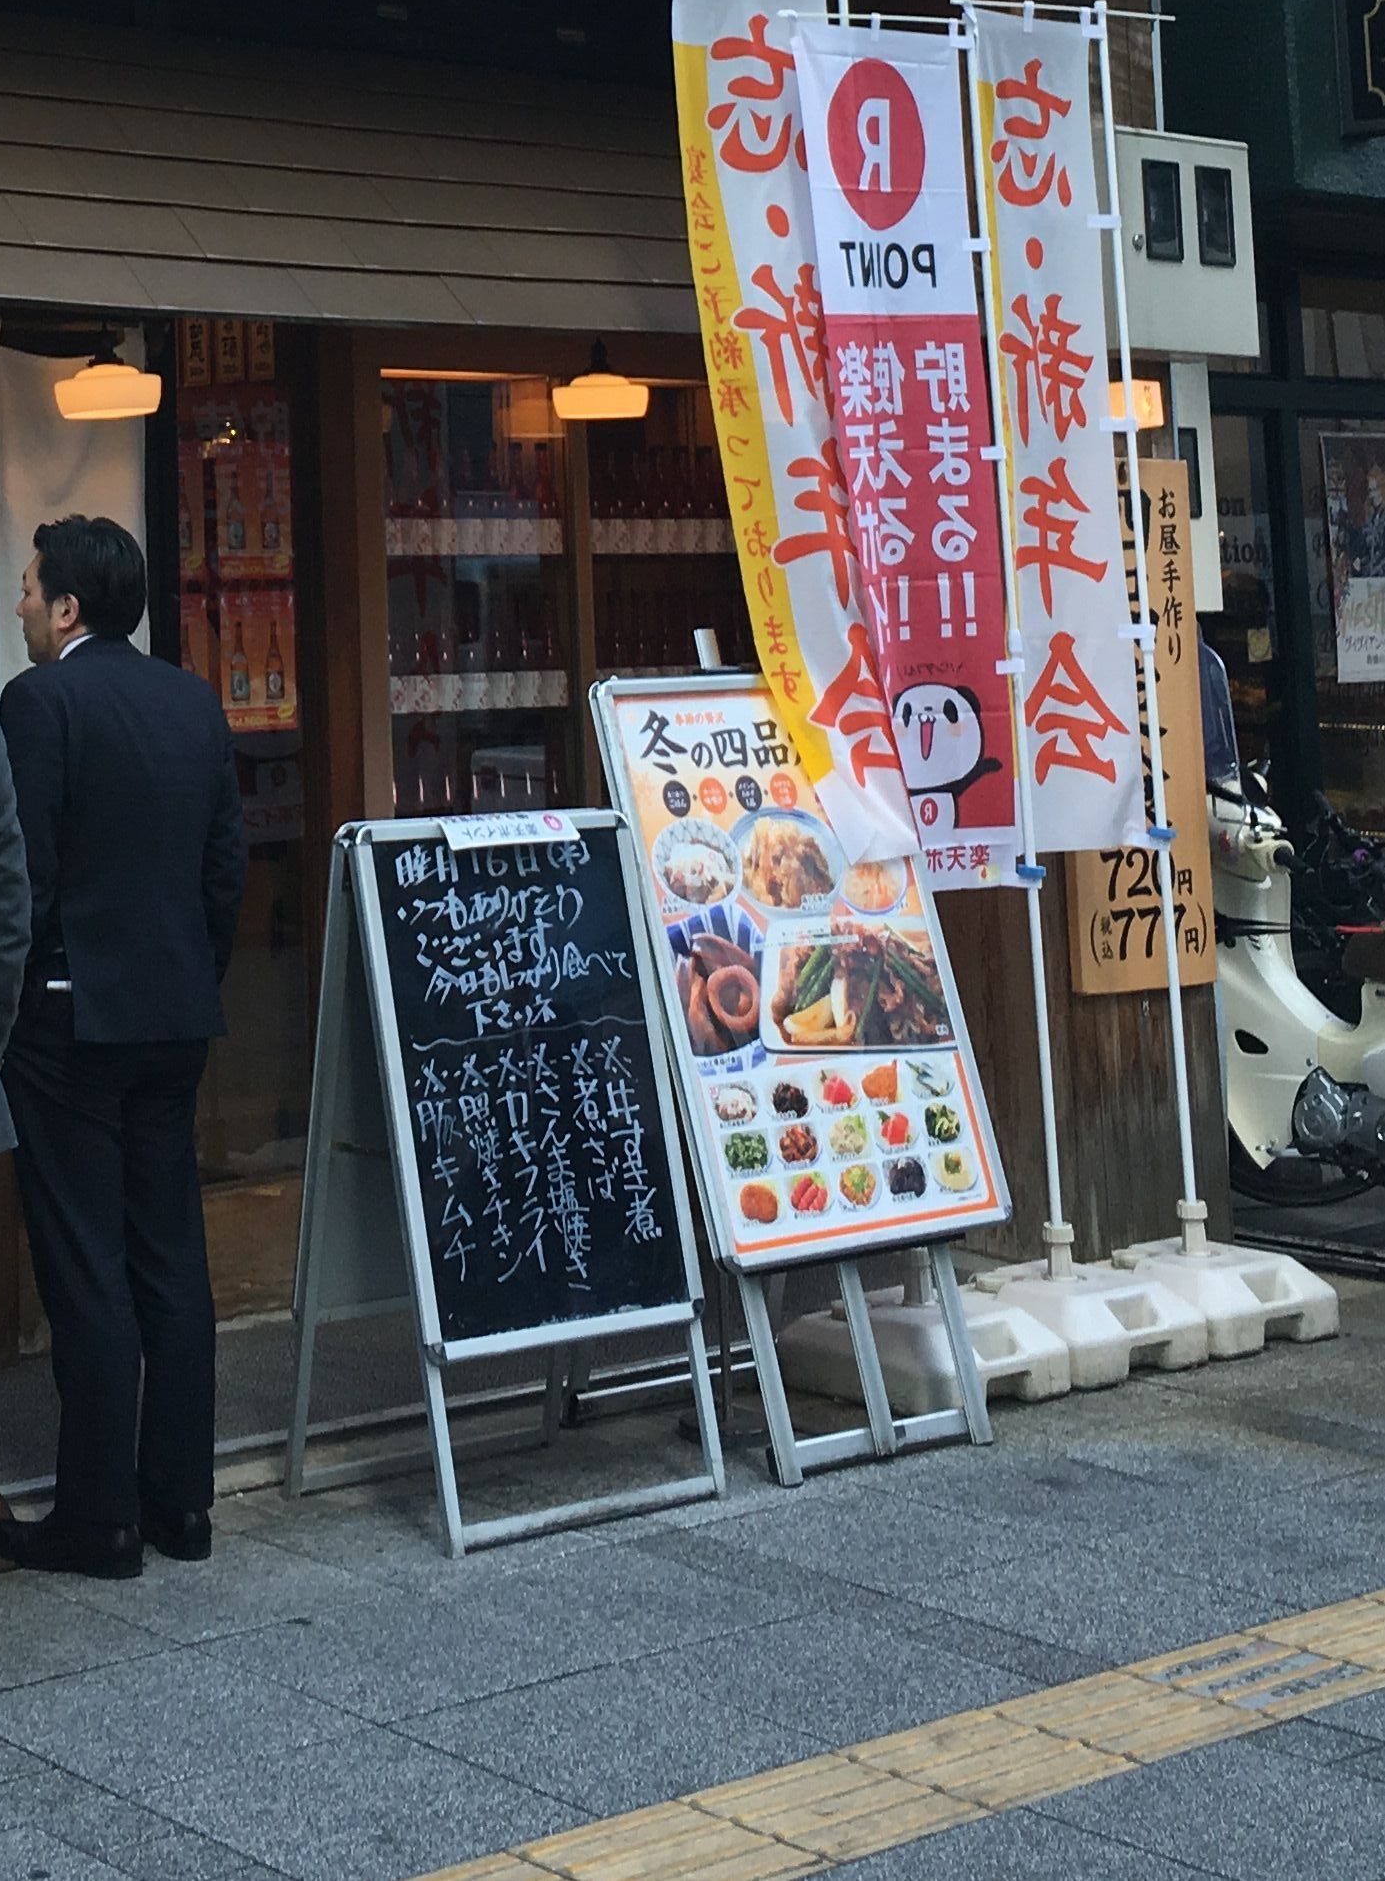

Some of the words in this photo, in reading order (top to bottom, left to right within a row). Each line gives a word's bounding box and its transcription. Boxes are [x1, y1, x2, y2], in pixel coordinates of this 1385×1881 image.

[1157, 487, 1183, 665] お昼手作り
[640, 709, 802, 775] 冬の四品
[416, 917, 553, 968] ございます
